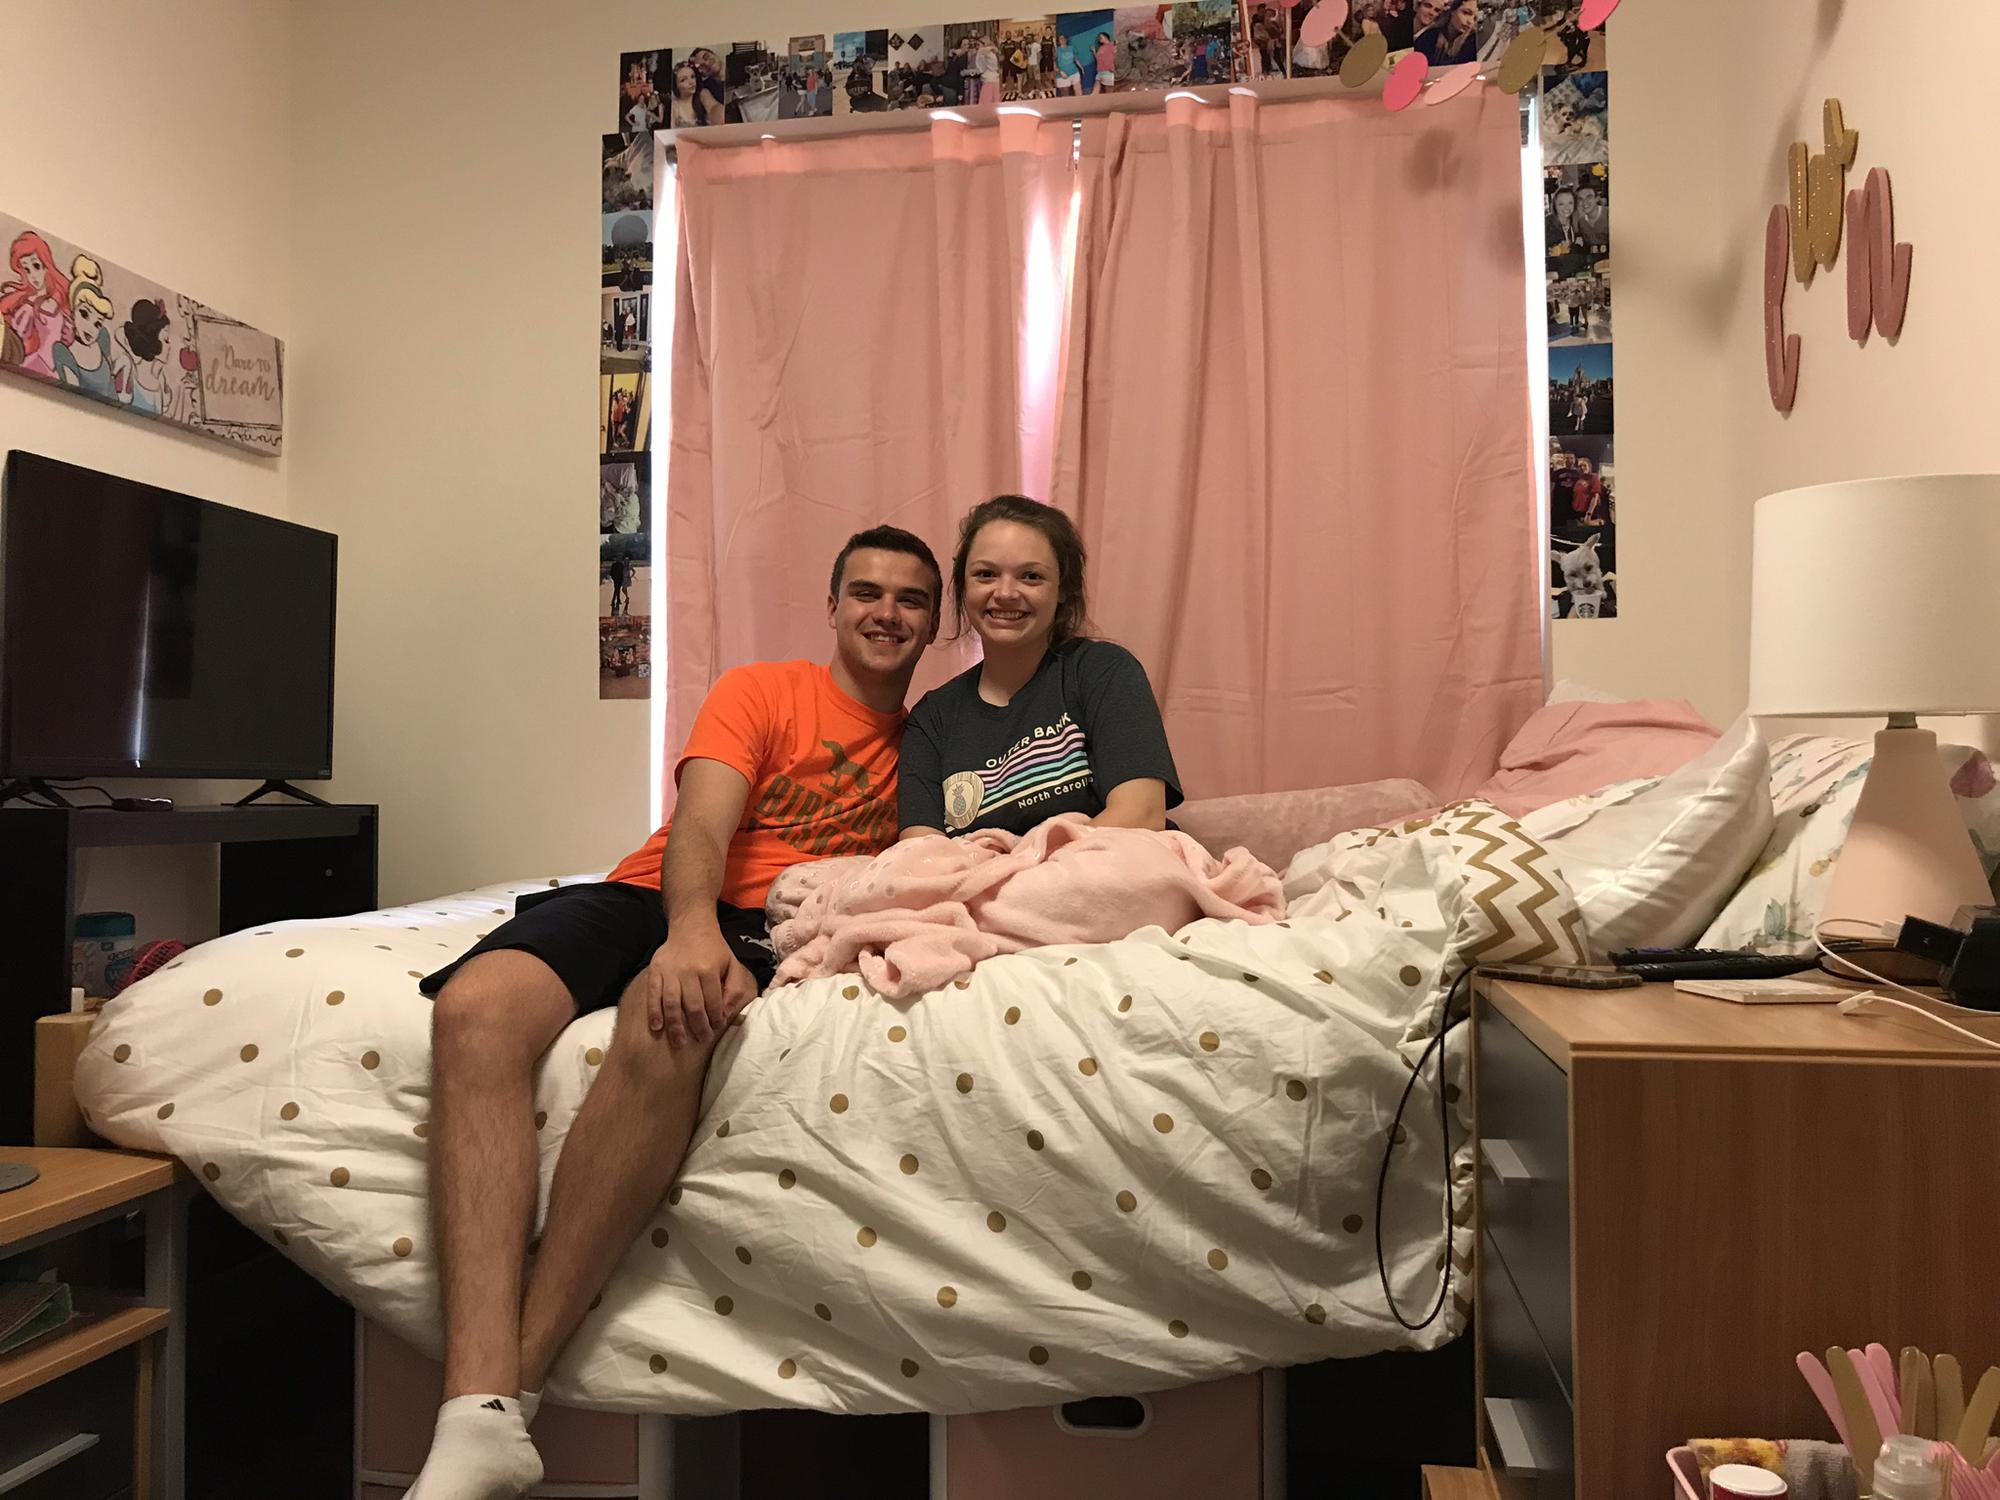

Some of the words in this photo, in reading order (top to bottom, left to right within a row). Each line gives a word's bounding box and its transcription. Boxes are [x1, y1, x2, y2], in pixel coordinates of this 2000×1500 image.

[205, 357, 275, 401] dream
[985, 736, 1030, 768] OUTER
[1034, 712, 1072, 738] BANK
[1018, 791, 1051, 809] North
[1054, 777, 1094, 795] Caroli
